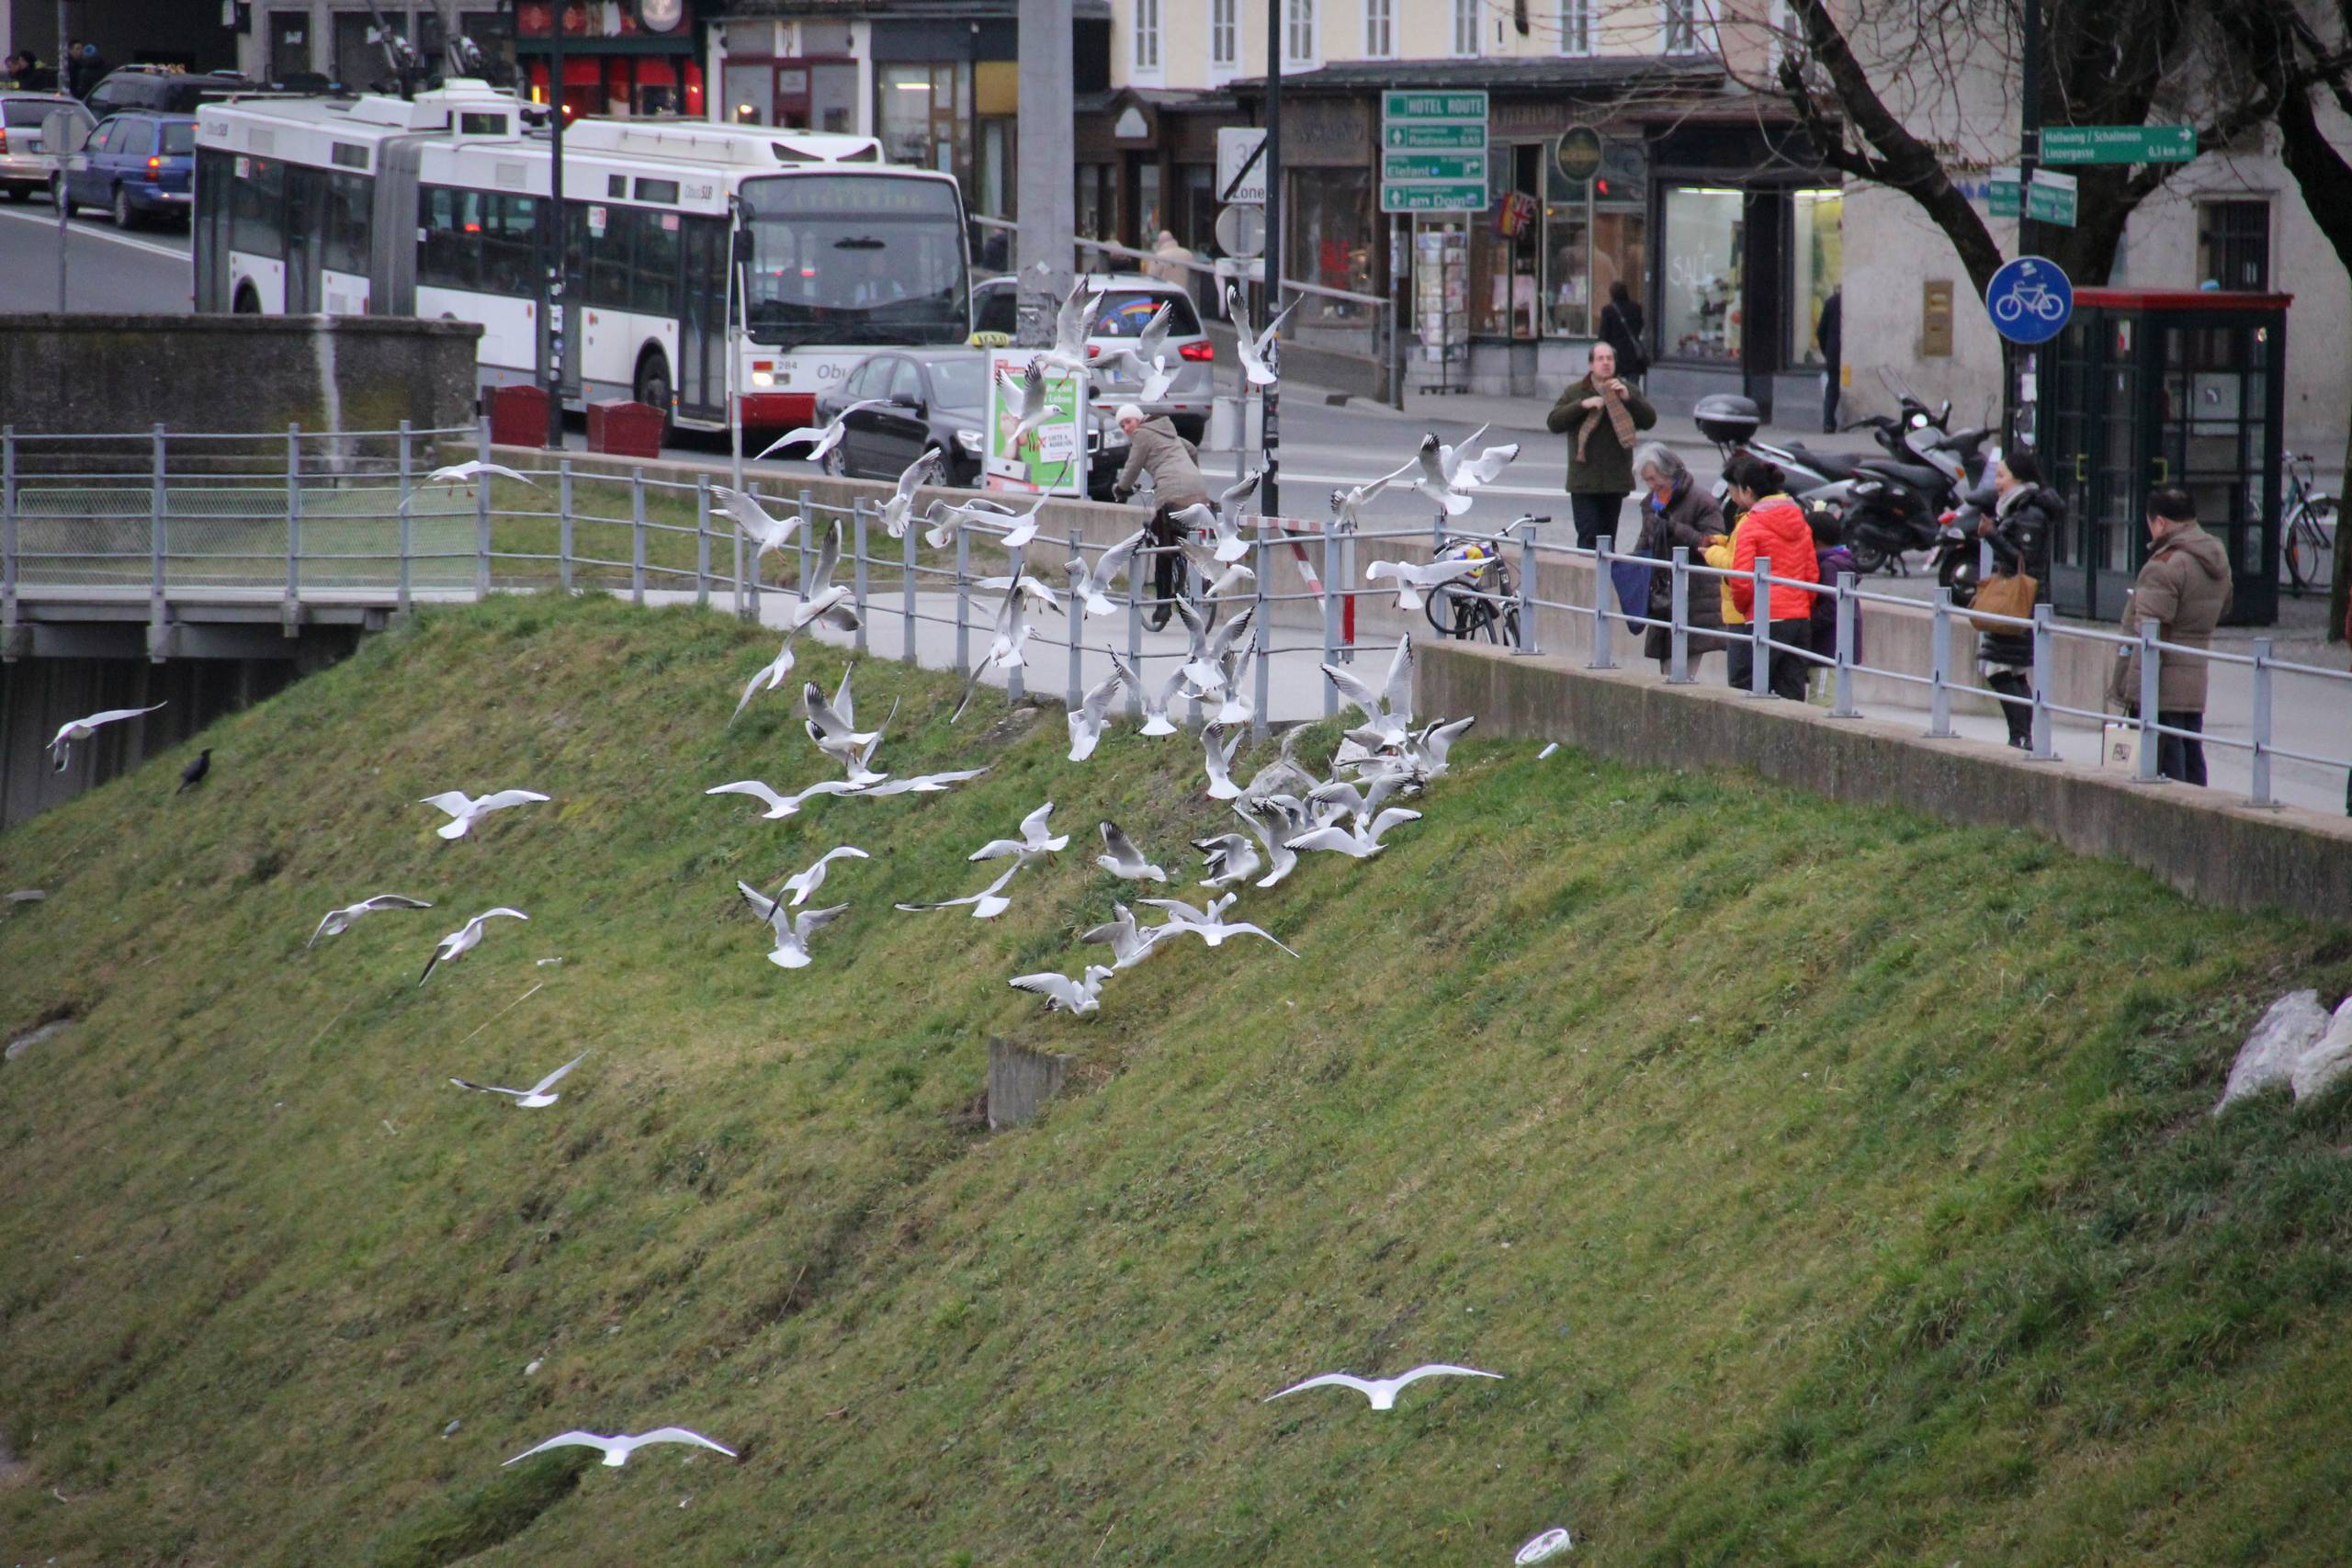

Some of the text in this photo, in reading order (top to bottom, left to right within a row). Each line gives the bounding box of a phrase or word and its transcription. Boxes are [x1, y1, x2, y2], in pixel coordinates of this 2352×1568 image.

[1408, 98, 1442, 114] HOTEL
[1448, 98, 1484, 114] ROUTE
[2045, 131, 2086, 145] Hallwang
[2094, 130, 2142, 142] Schallmoos
[2045, 148, 2095, 161] Linzergasse
[2163, 145, 2177, 156] km
[1387, 166, 1430, 177] Elefant
[1233, 187, 1265, 199] Zone
[1408, 194, 1466, 208] am Dom
[778, 361, 797, 370] 284
